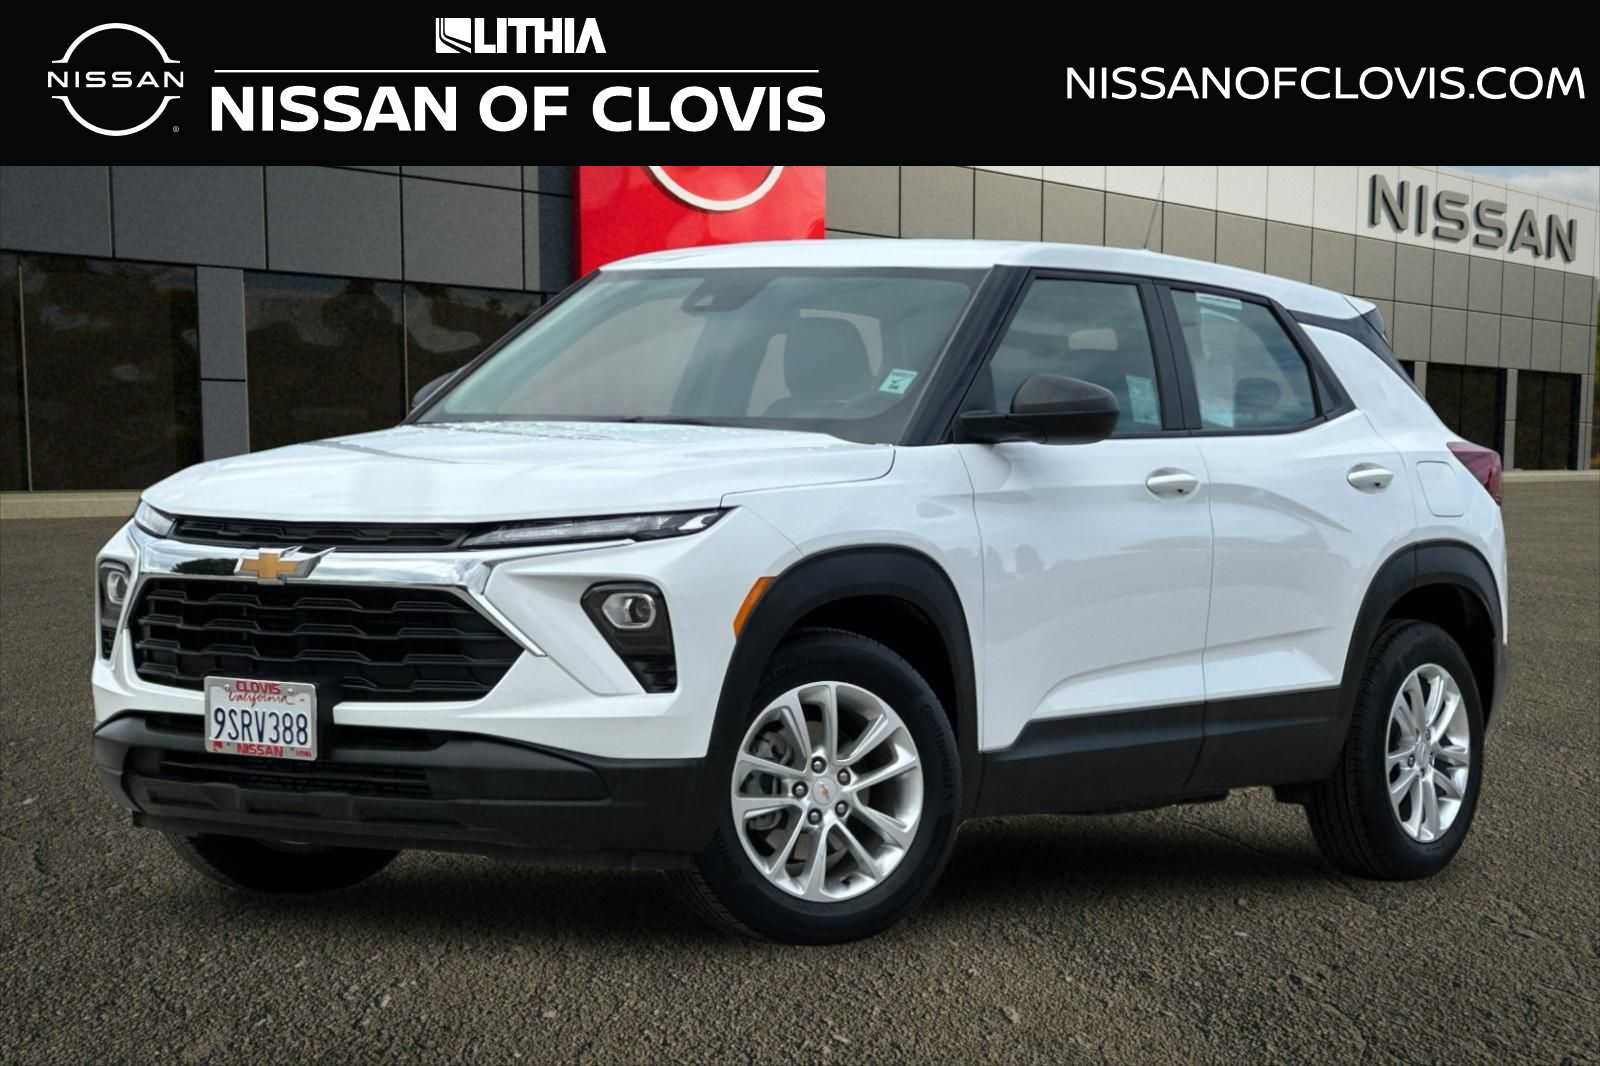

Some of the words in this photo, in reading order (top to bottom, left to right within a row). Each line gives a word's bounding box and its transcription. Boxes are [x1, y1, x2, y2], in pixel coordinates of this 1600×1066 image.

[1368, 174, 1578, 263] NISSAN
[235, 680, 282, 695] CLOVIS
[213, 707, 309, 746] 9SRV388
[236, 743, 284, 757] NISSAN
